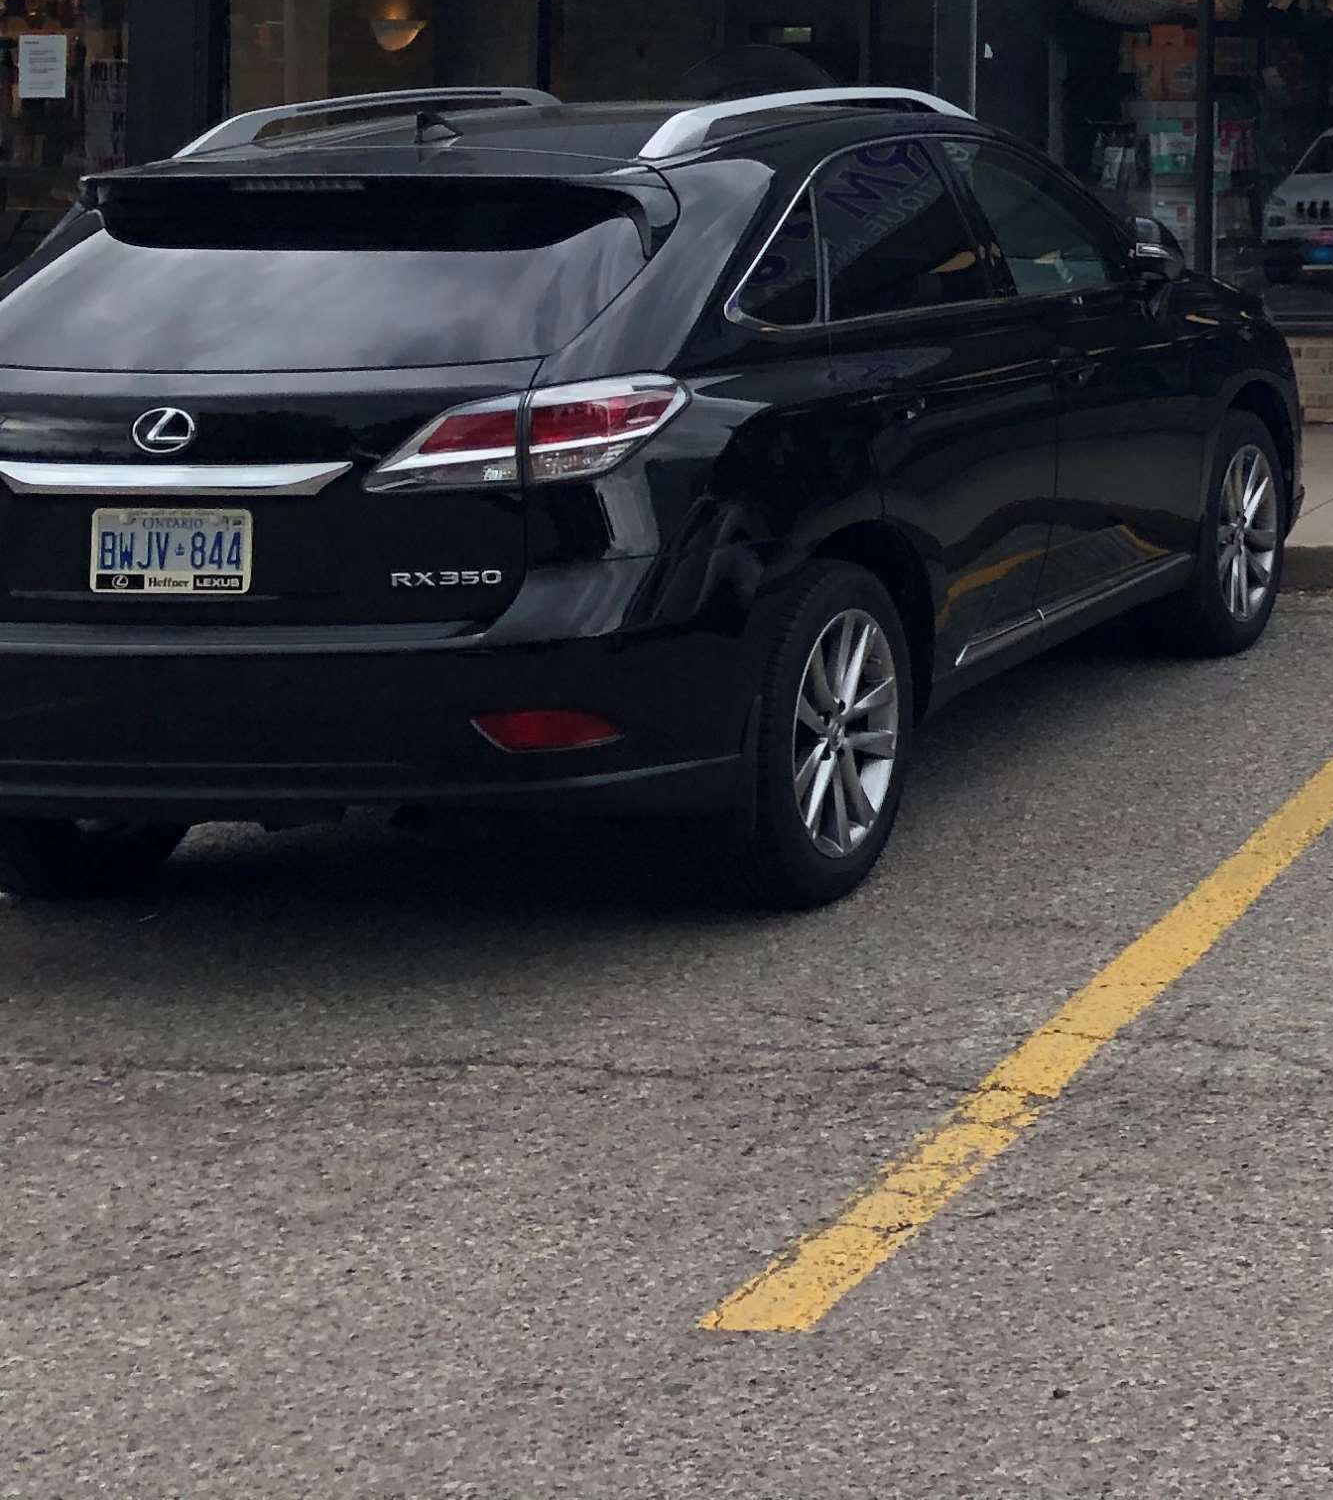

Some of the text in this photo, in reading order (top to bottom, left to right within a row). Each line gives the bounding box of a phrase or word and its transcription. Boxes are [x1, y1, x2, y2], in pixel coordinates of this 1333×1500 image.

[142, 517, 204, 530] ONTARIO
[100, 531, 241, 571] BWJV 844
[148, 576, 241, 589] Heffner LEXUS
